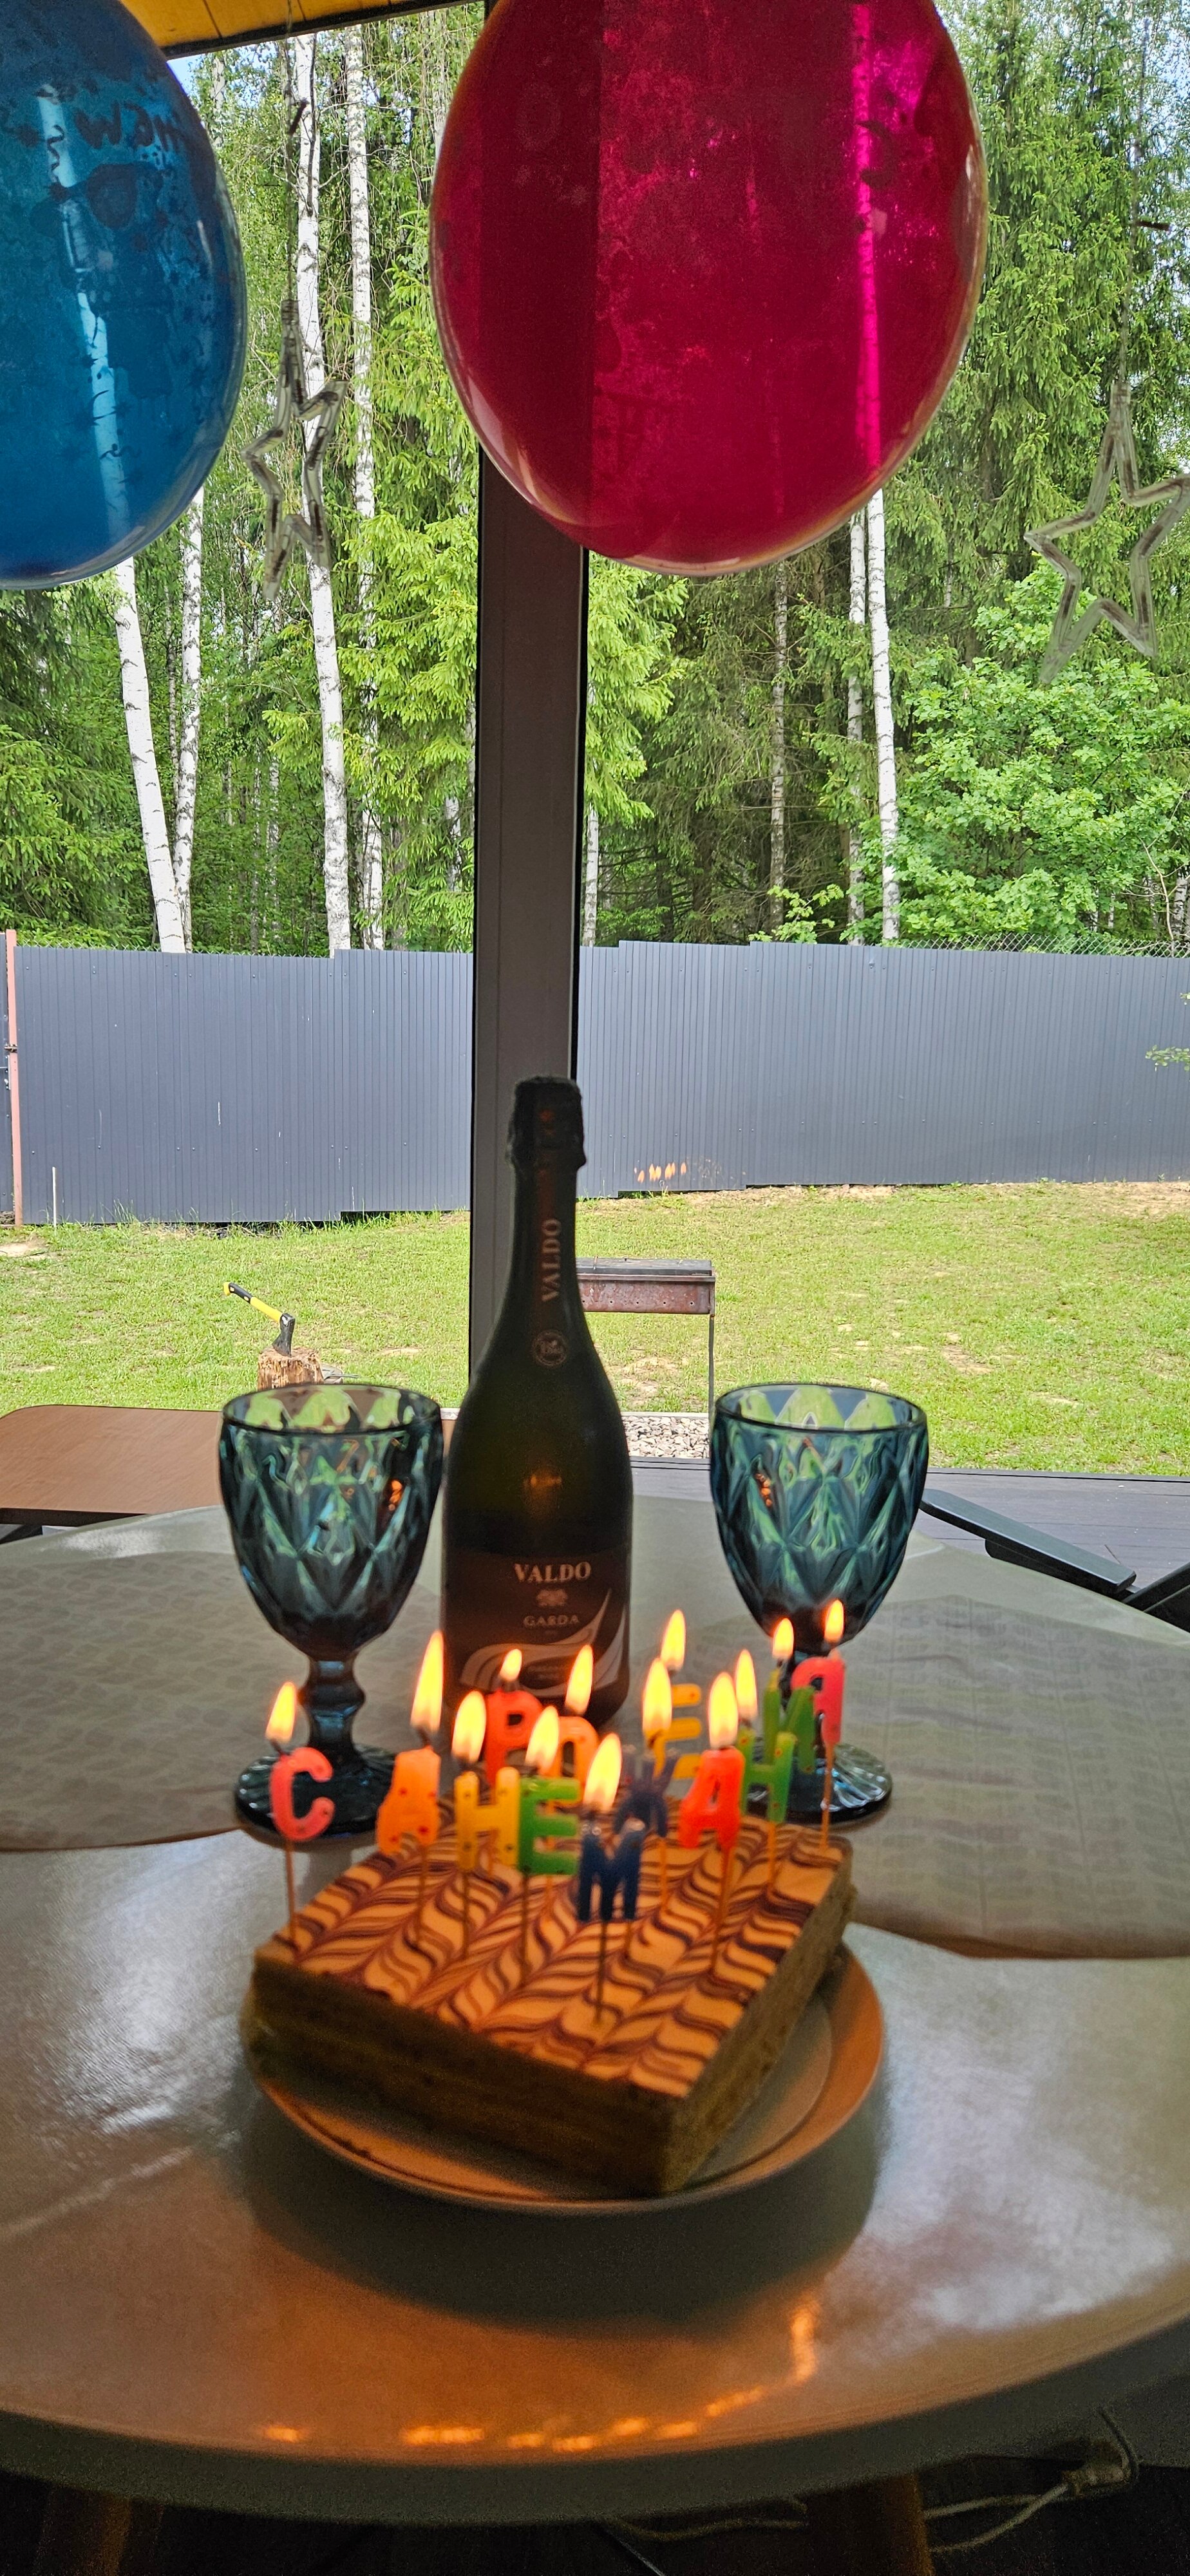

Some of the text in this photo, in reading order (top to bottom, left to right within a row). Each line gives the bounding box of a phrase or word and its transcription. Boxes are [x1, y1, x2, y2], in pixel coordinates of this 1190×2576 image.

[542, 1219, 560, 1302] VALDO
[515, 1562, 592, 1582] VALDO
[524, 1615, 580, 1627] GARDA
